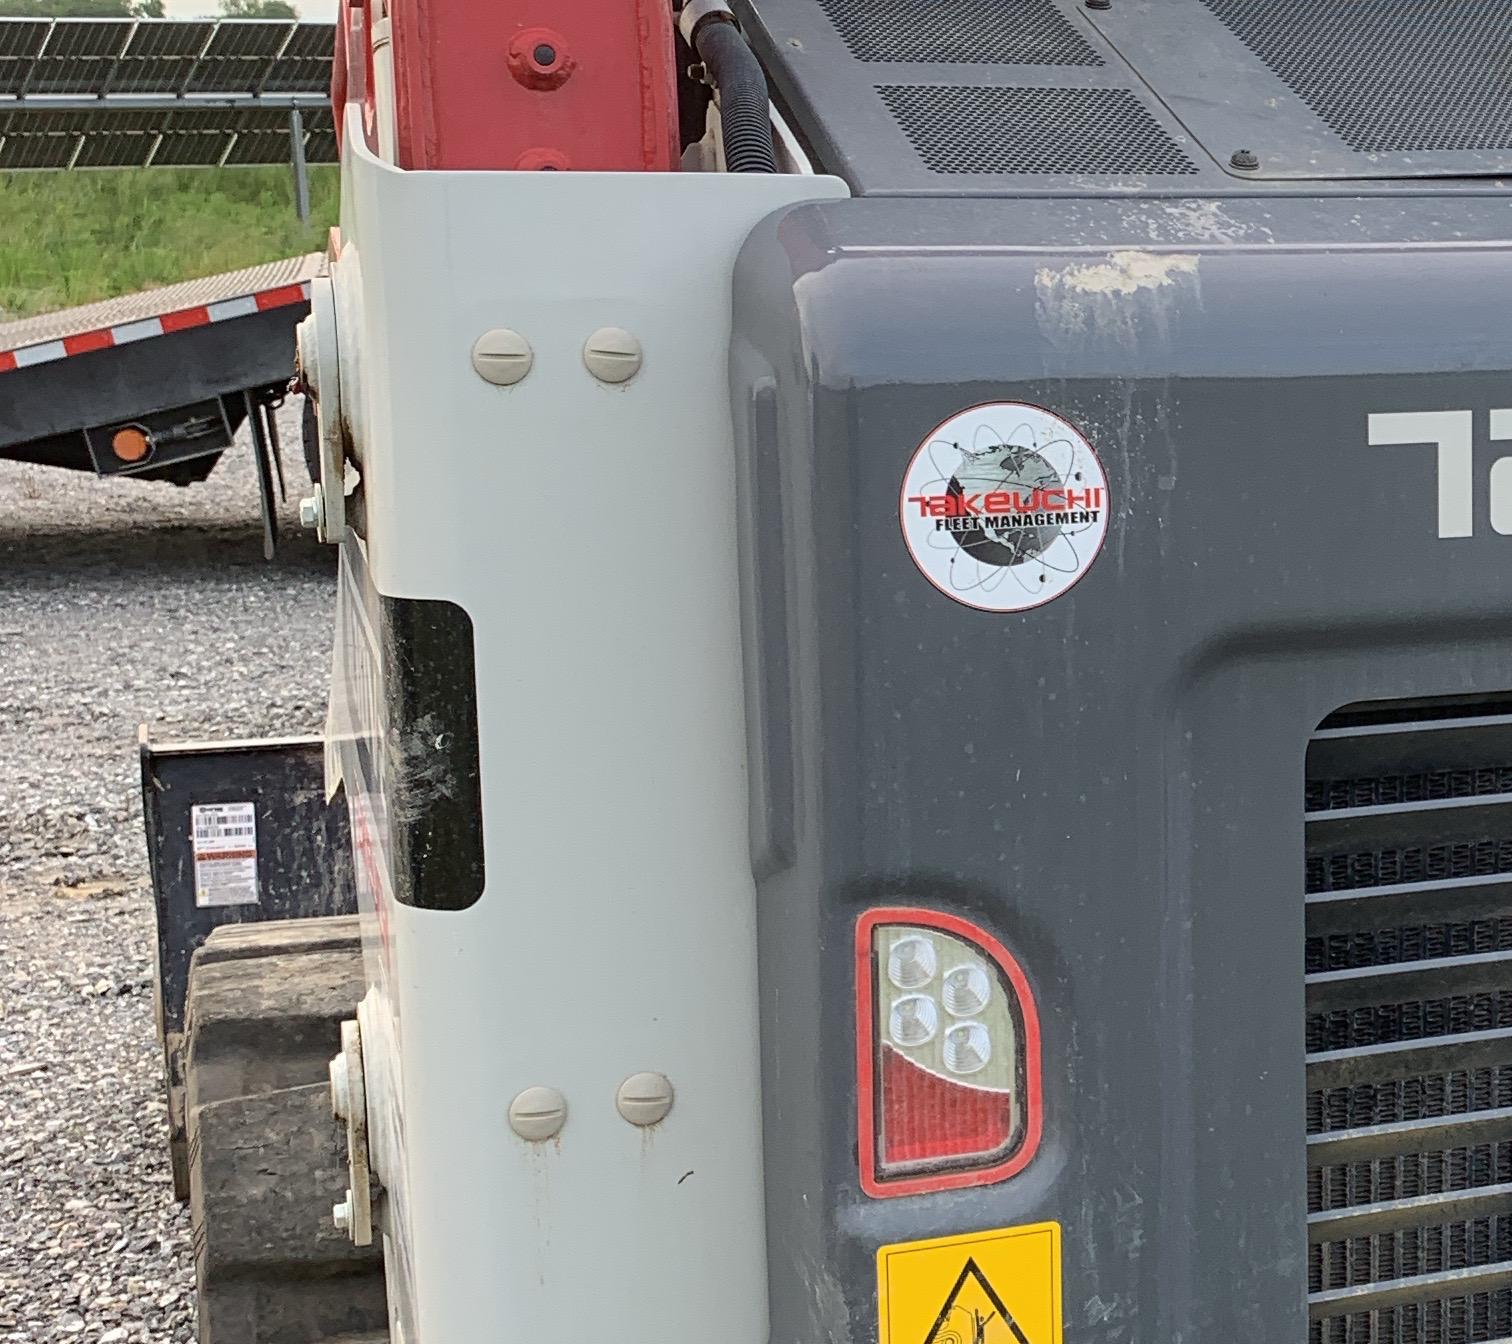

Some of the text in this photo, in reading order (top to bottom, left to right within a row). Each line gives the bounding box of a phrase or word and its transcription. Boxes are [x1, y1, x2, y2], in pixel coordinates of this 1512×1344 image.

[908, 487, 1101, 518] TAKEUCHI
[935, 511, 1101, 532] FLEET MANAGEMENT
